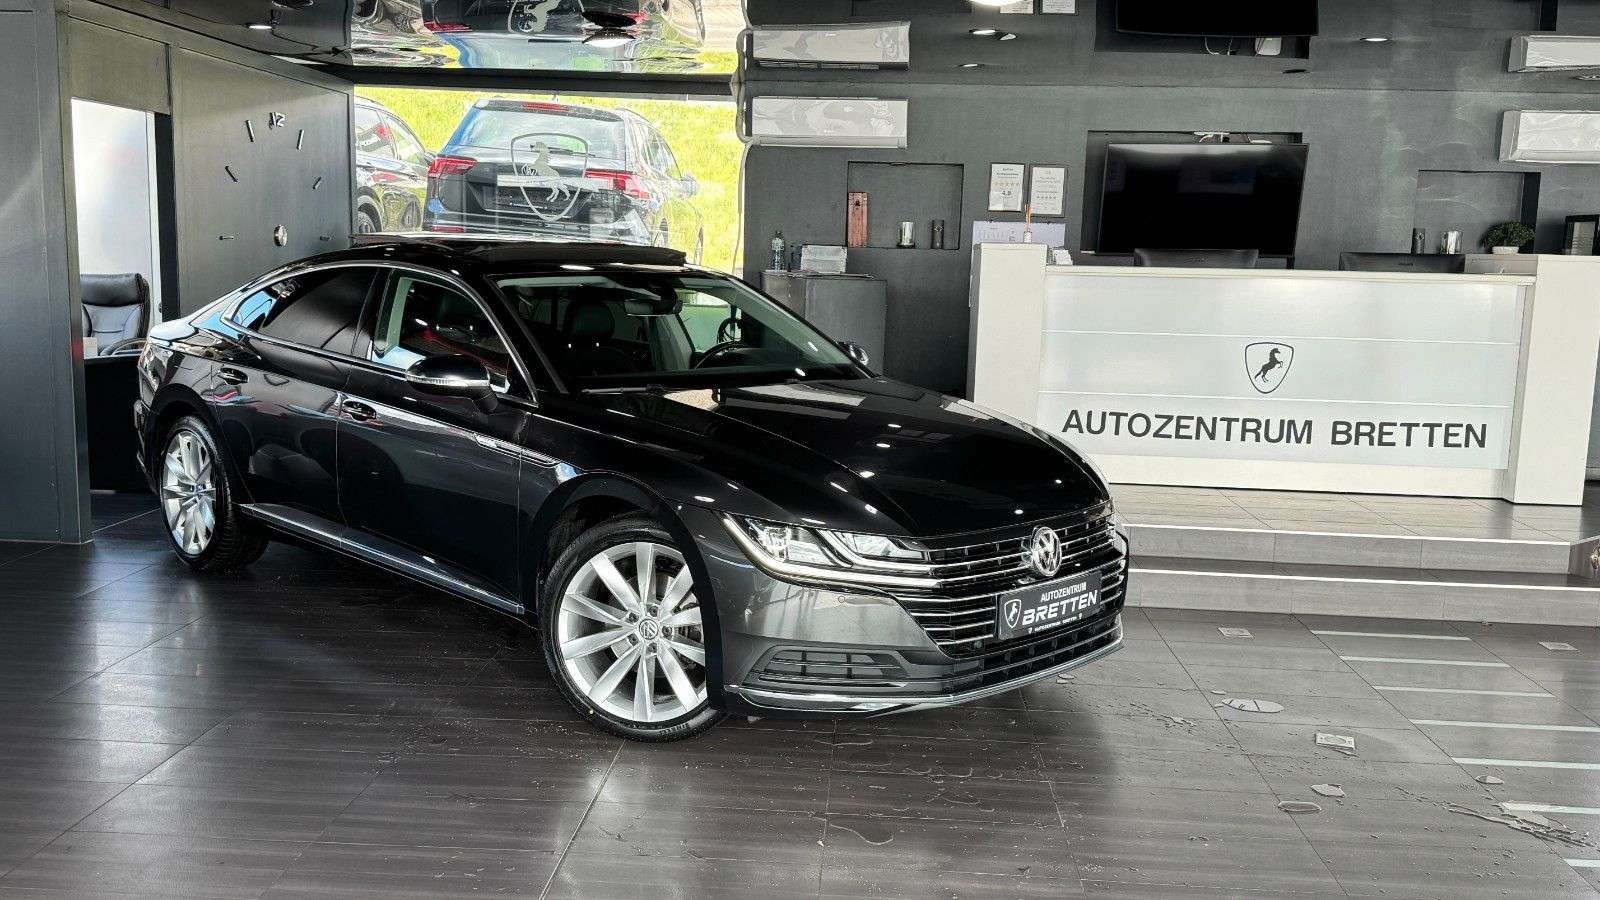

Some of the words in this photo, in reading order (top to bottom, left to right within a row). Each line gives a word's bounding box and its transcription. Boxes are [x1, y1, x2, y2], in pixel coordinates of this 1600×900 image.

[1062, 409, 1312, 444] AUTOZENTRUM
[1331, 420, 1487, 448] BRETTEN
[1022, 590, 1098, 625] BRETTEN
[1041, 582, 1087, 602] AUTOZENTRUM
